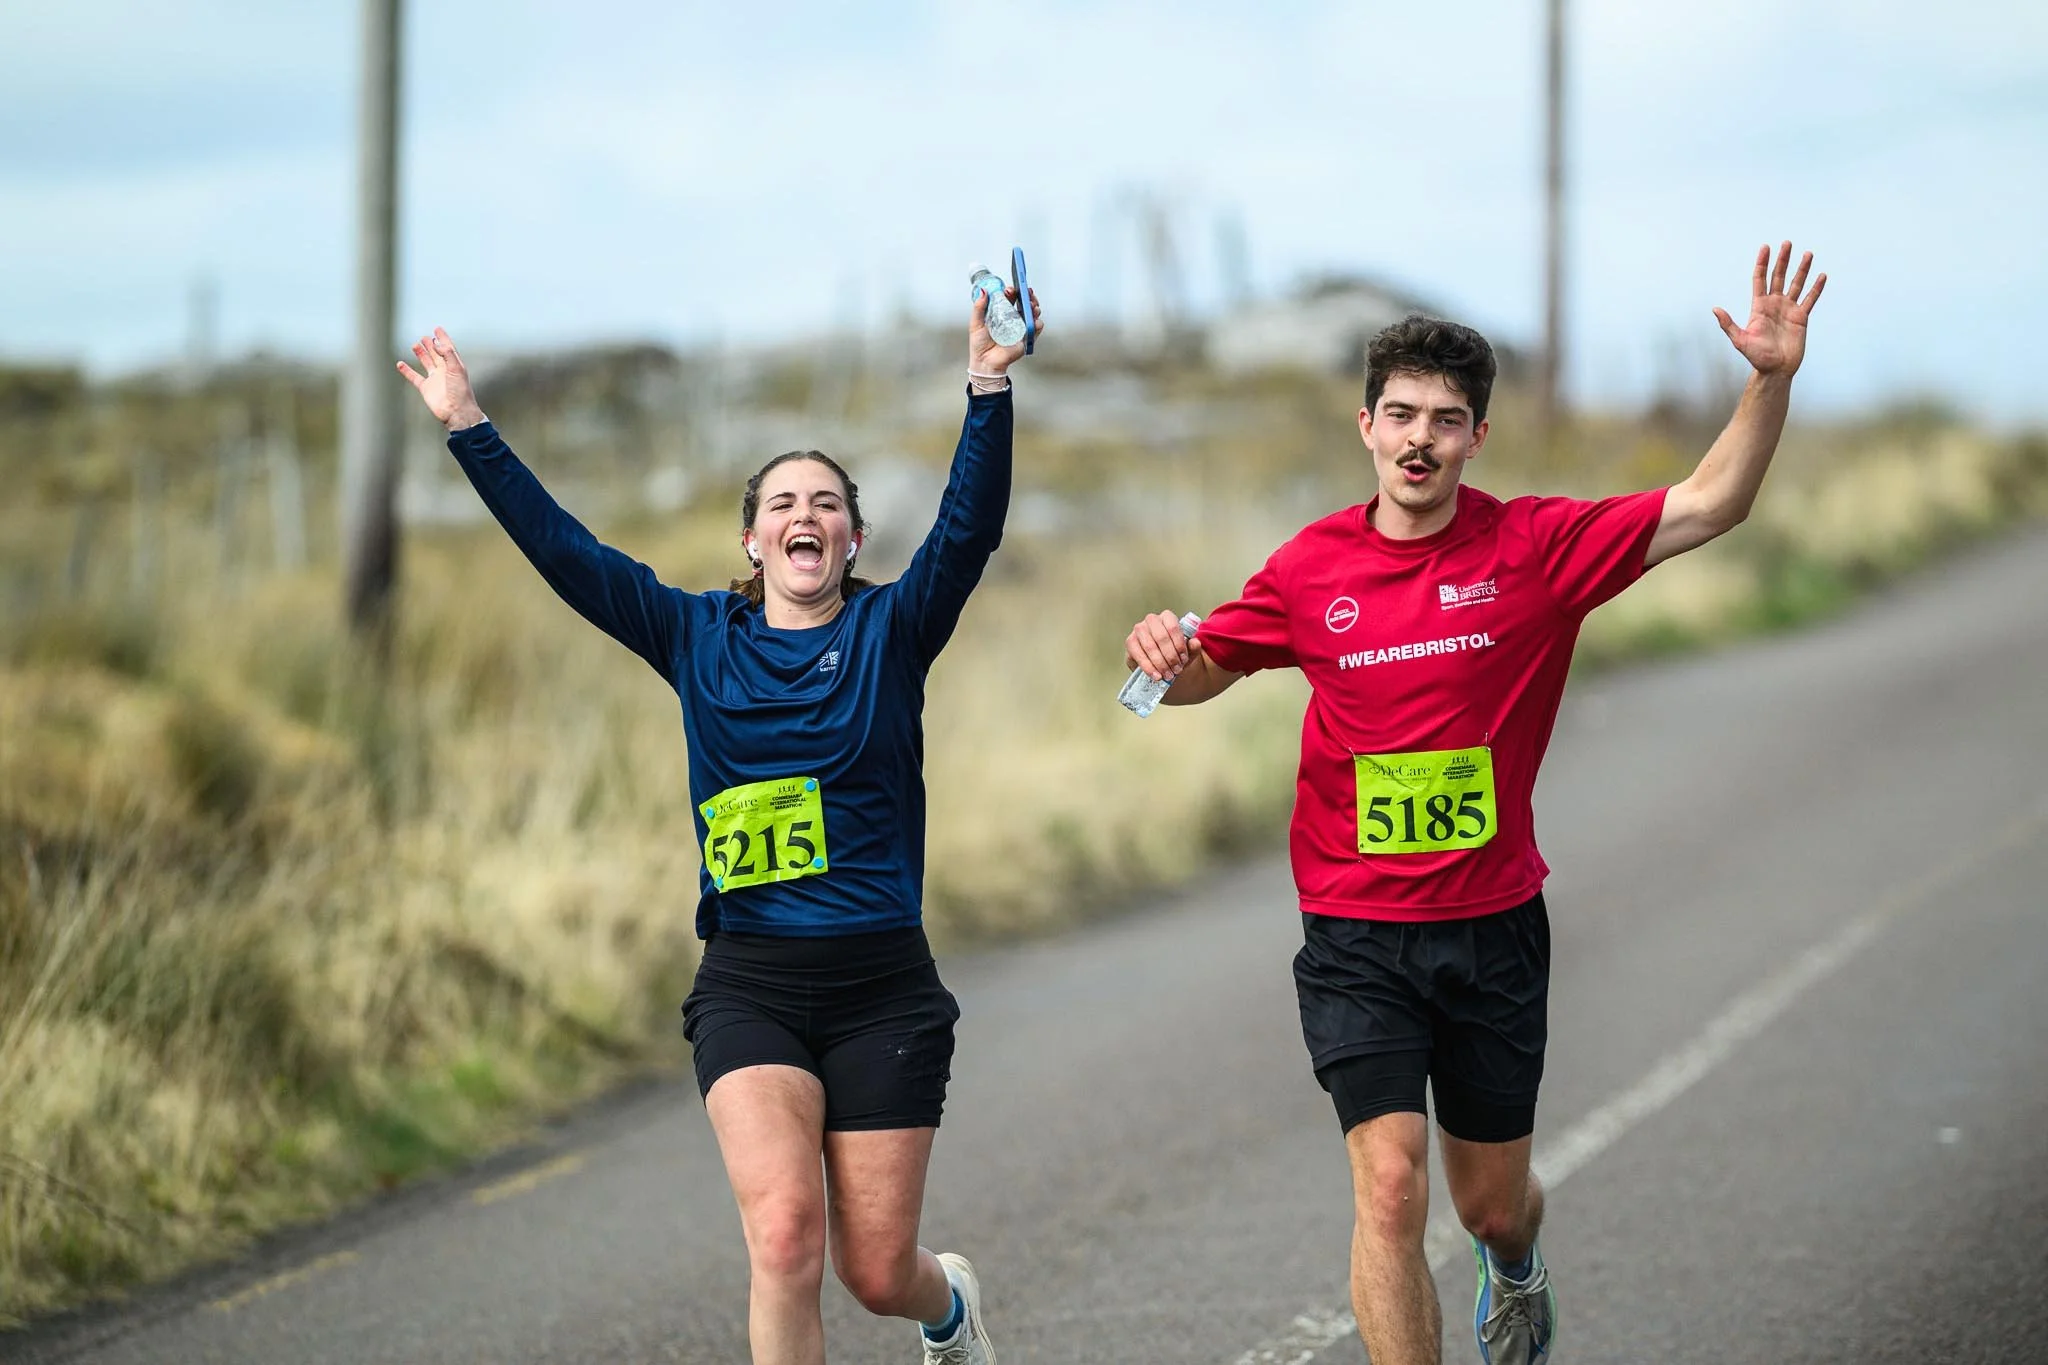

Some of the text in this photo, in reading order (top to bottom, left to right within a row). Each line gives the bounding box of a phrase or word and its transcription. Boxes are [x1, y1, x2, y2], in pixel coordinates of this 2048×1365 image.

[1459, 578, 1495, 593] University of
[1460, 586, 1499, 600] BRISTOL
[1338, 632, 1495, 670] #WEAREBRISTOL
[1380, 764, 1431, 776] WeCare
[1442, 768, 1478, 776] INTERNATIONAL
[769, 797, 806, 806] INTERNATIONAL
[772, 793, 802, 801] CONNEMARA
[1367, 791, 1486, 842] 5185
[712, 821, 816, 879] 5215
